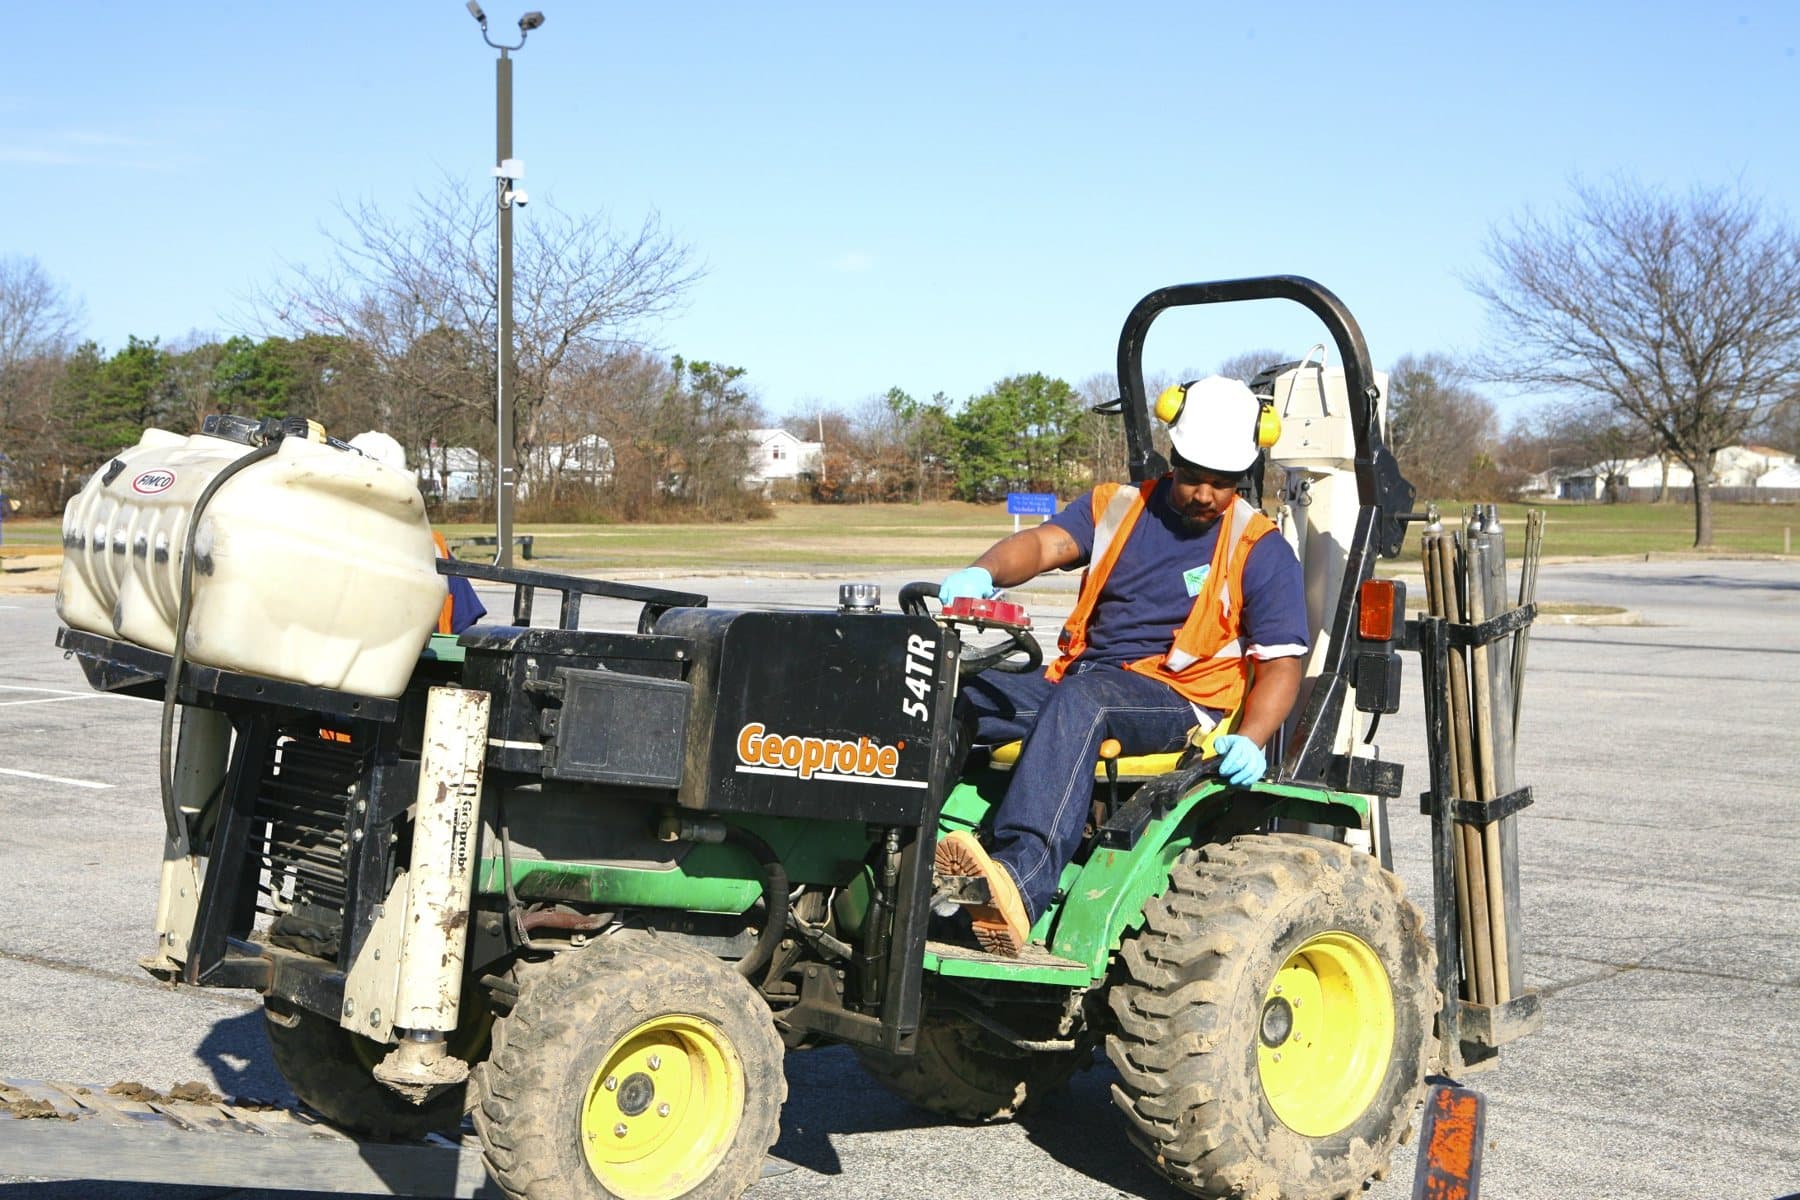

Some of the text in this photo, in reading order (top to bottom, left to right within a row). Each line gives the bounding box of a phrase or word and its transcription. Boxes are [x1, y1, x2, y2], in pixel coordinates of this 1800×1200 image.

[137, 474, 171, 488] FIMCO
[902, 633, 936, 722] 54TR
[736, 722, 899, 780] Geoprobe
